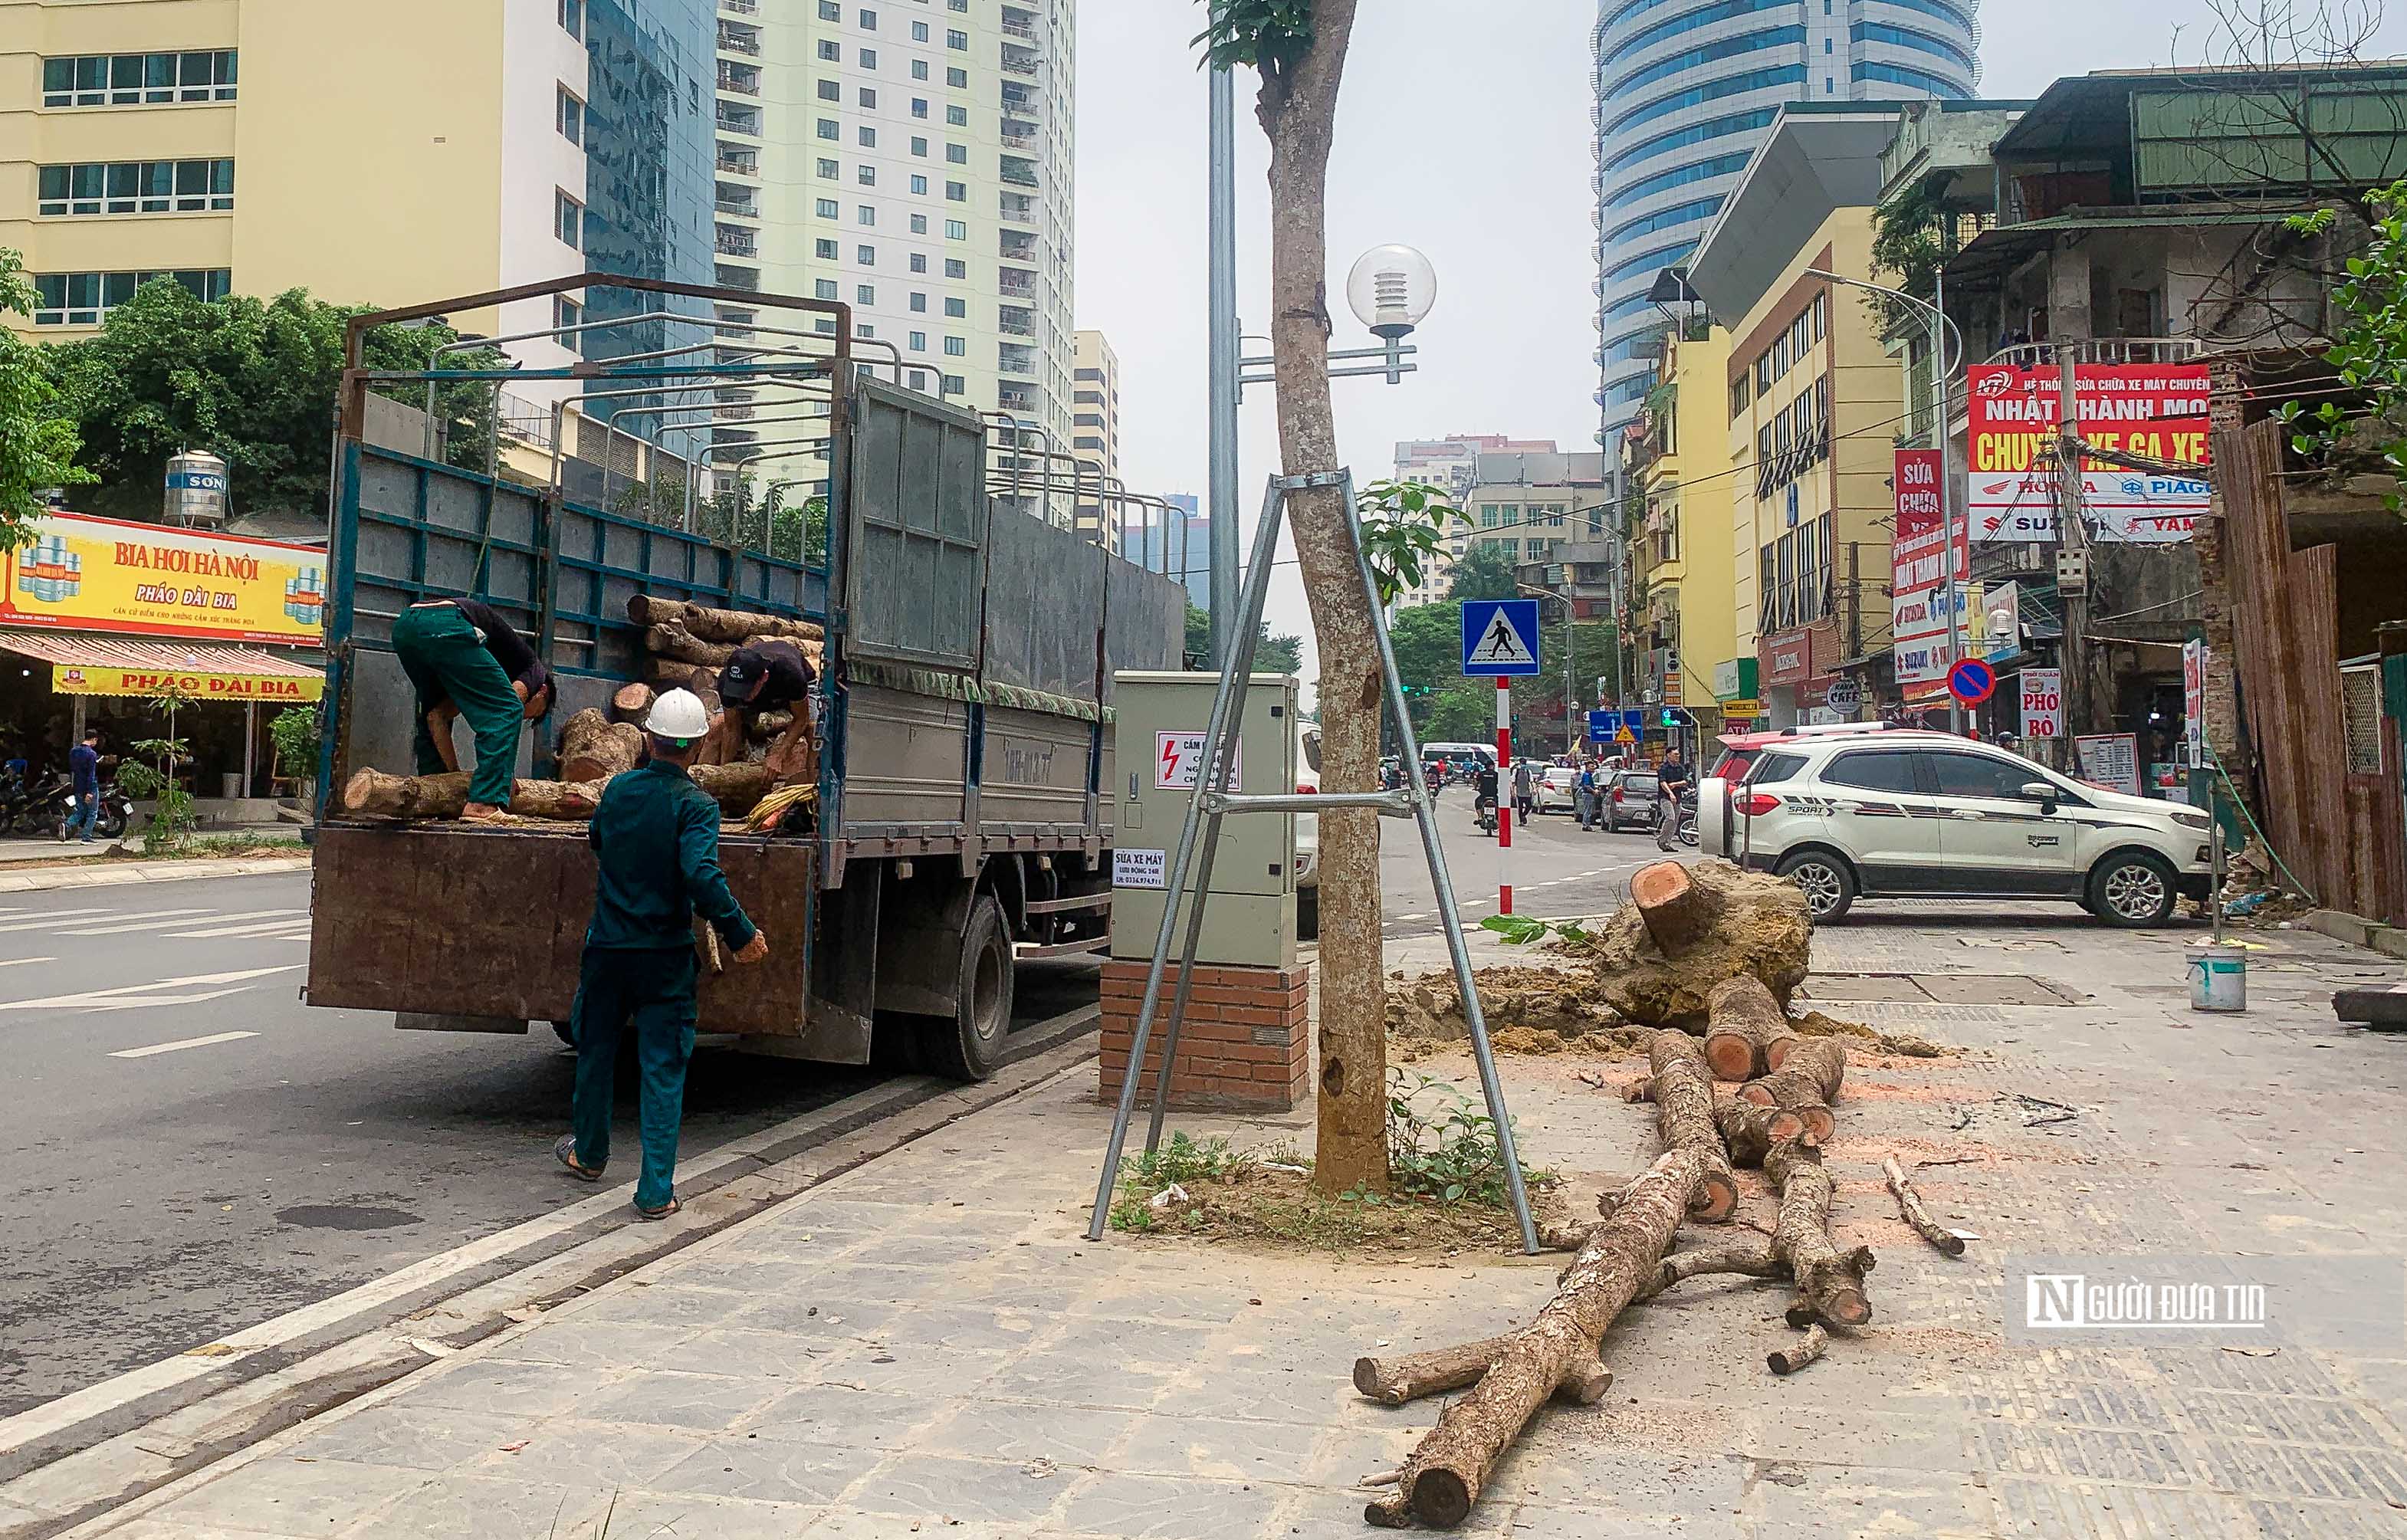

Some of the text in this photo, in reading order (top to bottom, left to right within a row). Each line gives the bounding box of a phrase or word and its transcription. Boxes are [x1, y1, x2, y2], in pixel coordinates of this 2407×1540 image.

[2075, 376, 2096, 391] SỬA
[2098, 377, 2126, 391] CHỮA
[2128, 379, 2141, 391] XE
[2143, 376, 2167, 391] MÁY
[2169, 376, 2211, 391] CHUYÊN
[1985, 395, 2210, 425] NHẬT HÀNH MO
[2087, 432, 2120, 471] XE
[2129, 432, 2164, 465] GA
[2171, 432, 2205, 467] XE
[1903, 457, 1934, 484] SỬA
[1900, 489, 1939, 514] CHỮA
[114, 540, 261, 586] BIA HƠI HÀ NỘI
[135, 581, 237, 609] PHÁO ĐÀI BIA
[1904, 603, 1927, 623] HONDA
[122, 673, 200, 691] PHÁO
[209, 676, 254, 694] ĐÀI
[261, 680, 299, 694] BIA
[2022, 686, 2059, 711] PHỞ
[1726, 726, 1751, 734] ATM
[2028, 714, 2054, 736] BÒ
[1115, 850, 1163, 865] SỬA XE MÁY
